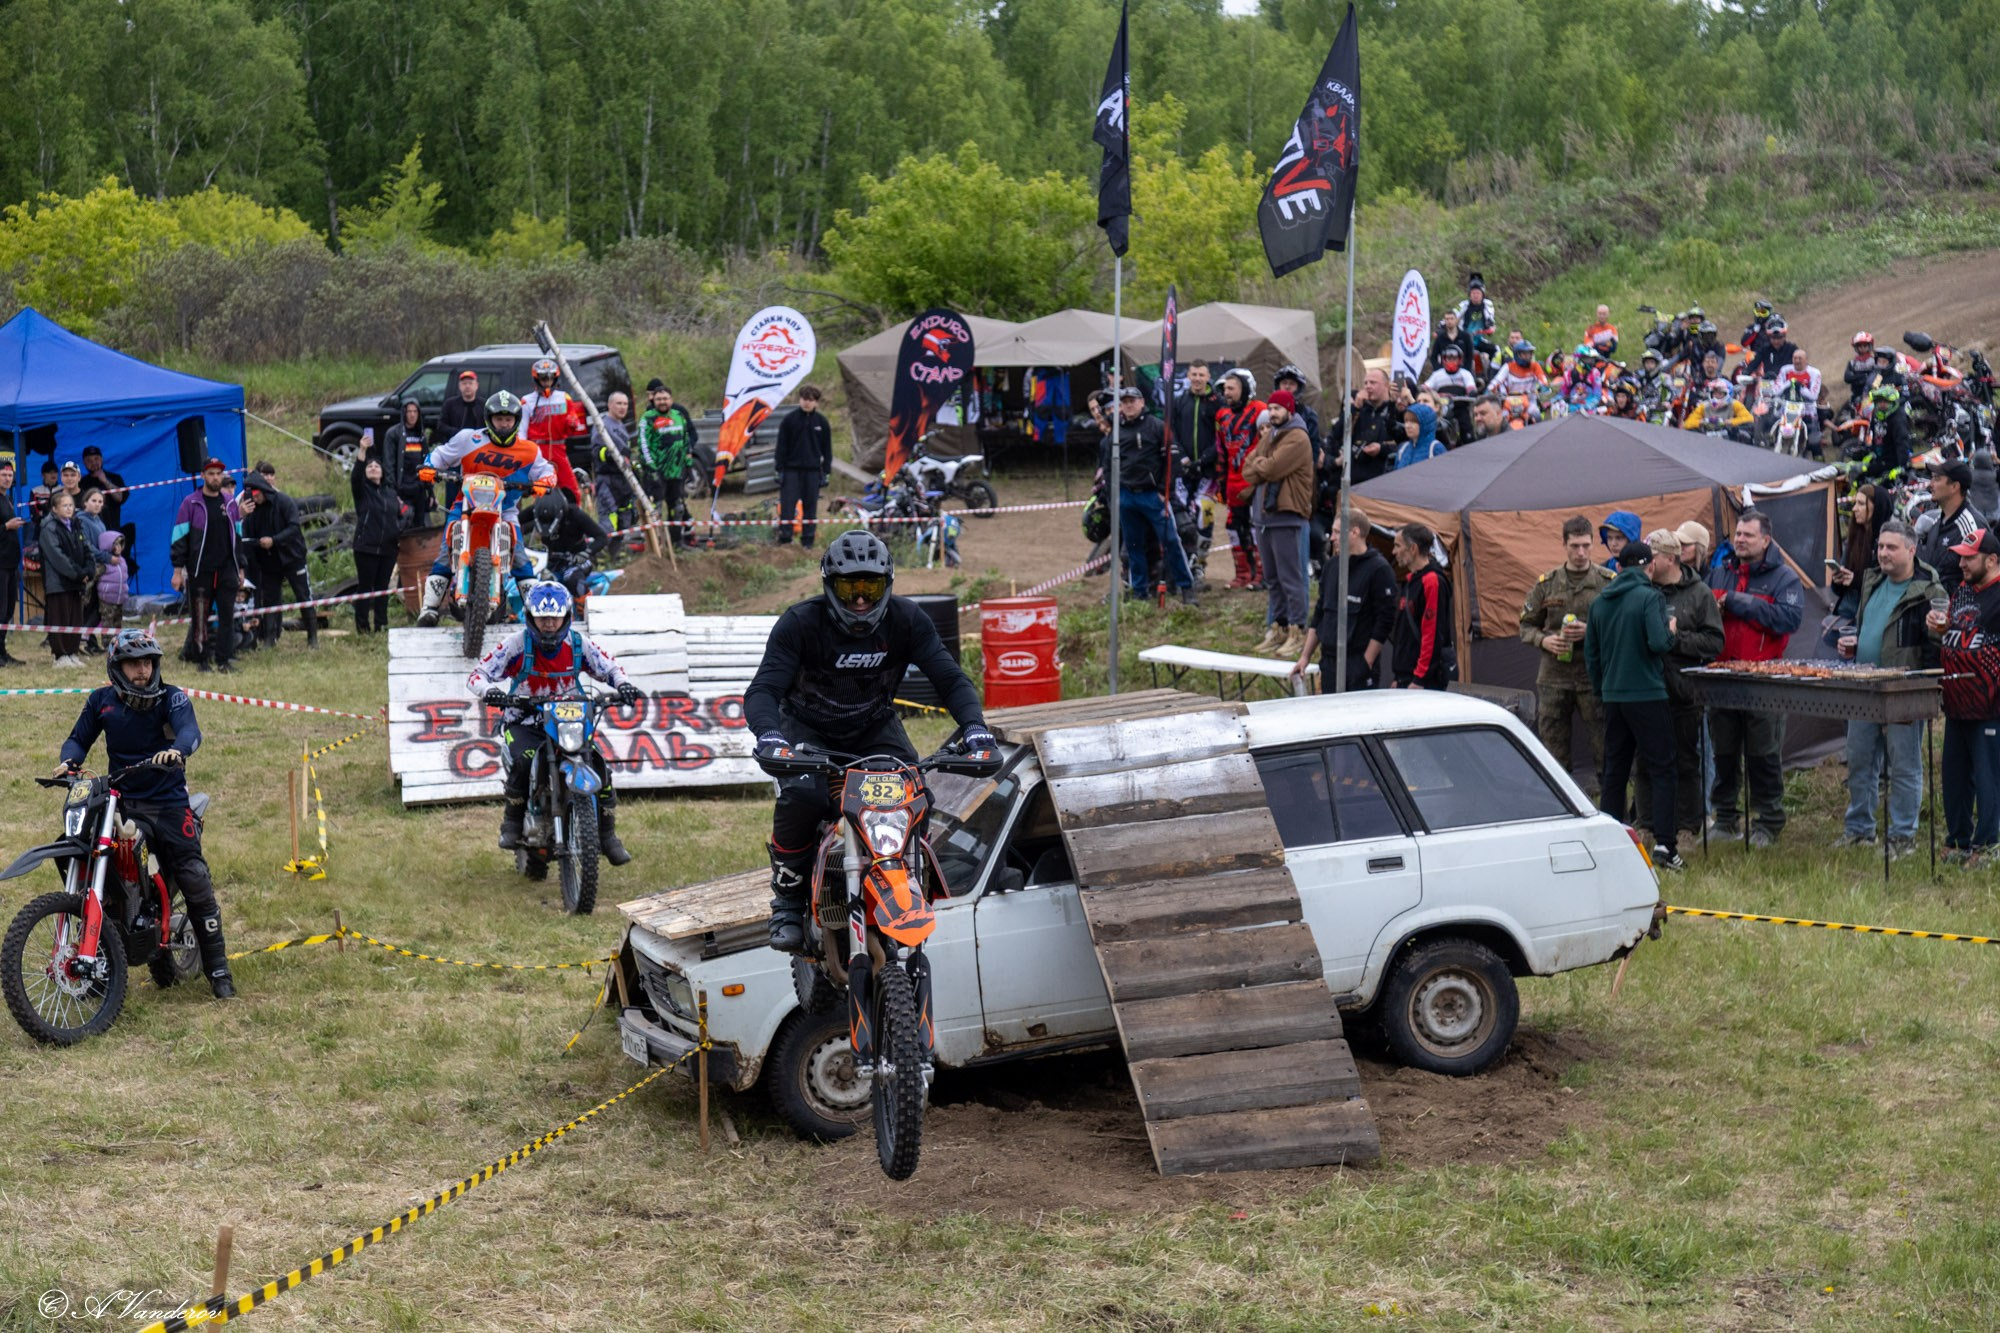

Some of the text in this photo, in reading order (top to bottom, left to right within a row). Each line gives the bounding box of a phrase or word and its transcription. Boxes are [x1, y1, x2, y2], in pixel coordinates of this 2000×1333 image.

[750, 315, 802, 336] СТАНКИ ЧПУ
[909, 315, 970, 343] ENDURO
[741, 343, 808, 357] HYPERCUT
[473, 450, 522, 470] KTM
[835, 651, 889, 669] LEATT
[563, 709, 575, 717] 71
[872, 784, 893, 798] 82
